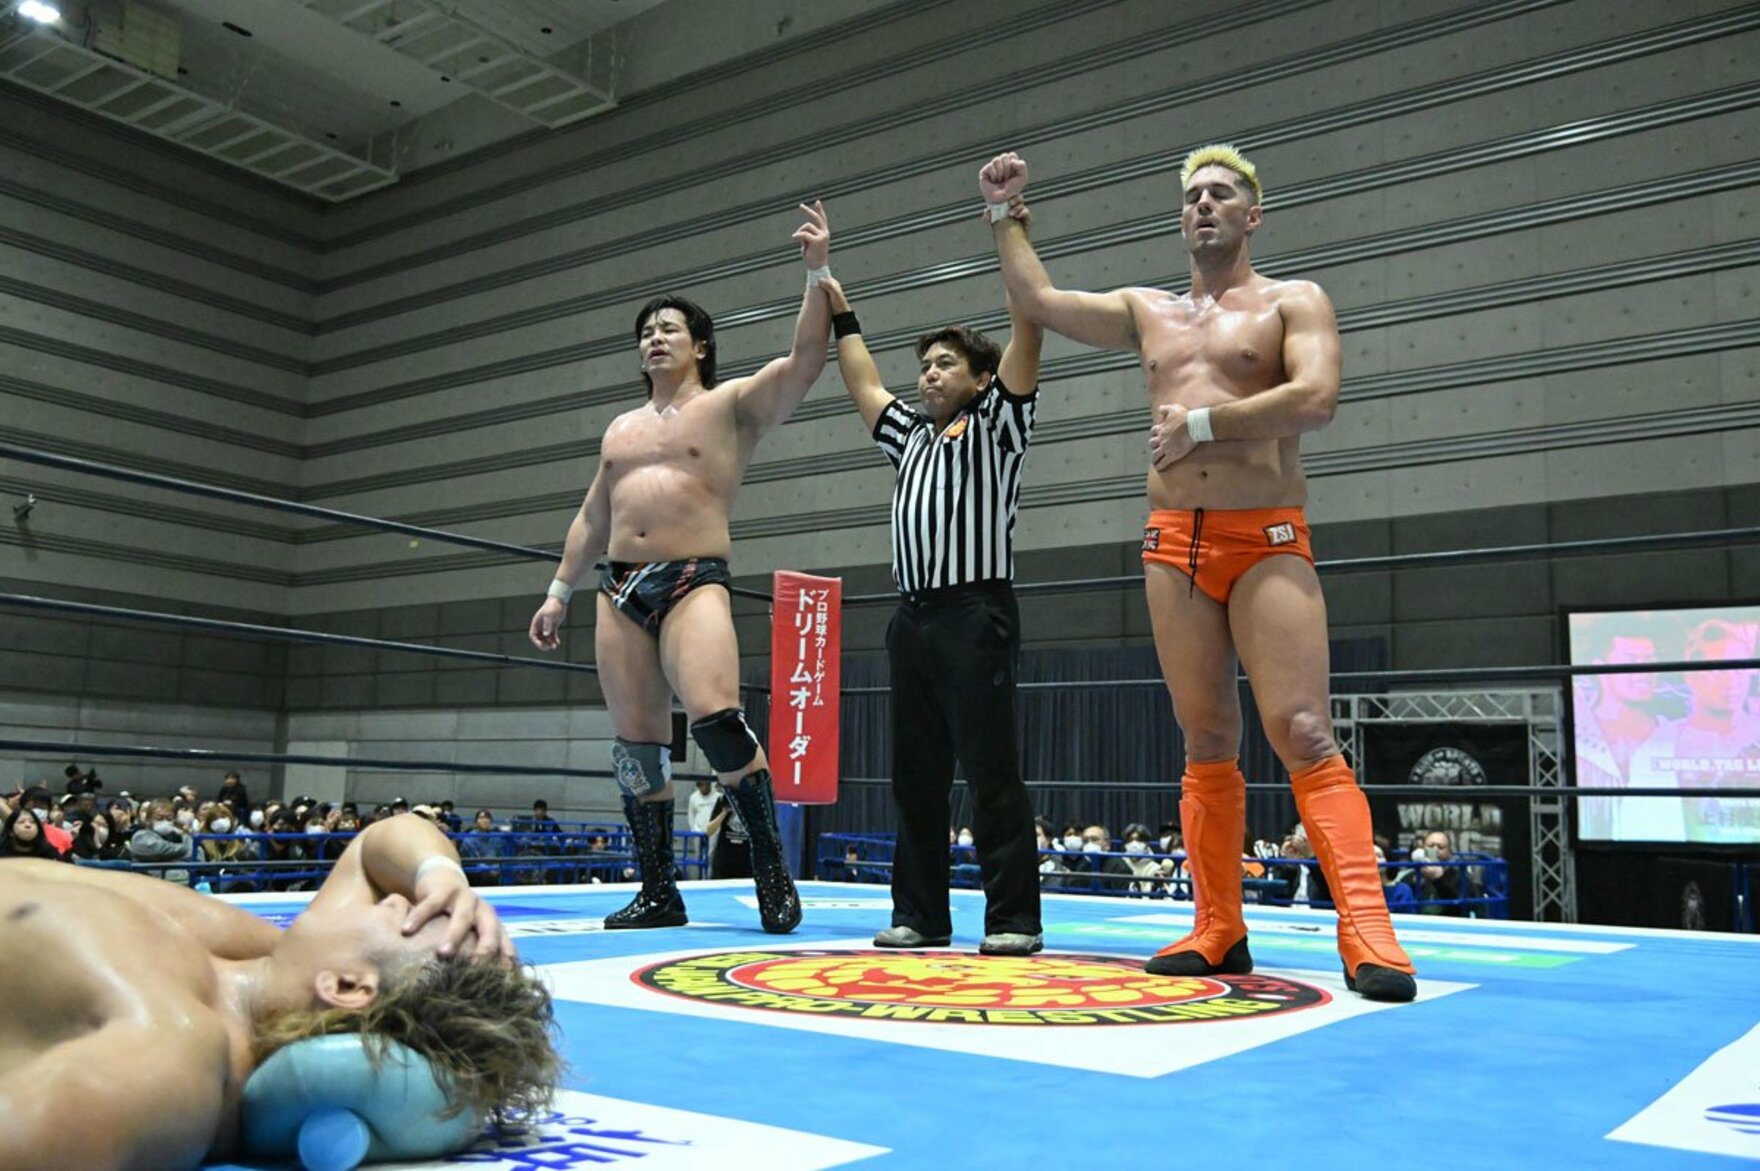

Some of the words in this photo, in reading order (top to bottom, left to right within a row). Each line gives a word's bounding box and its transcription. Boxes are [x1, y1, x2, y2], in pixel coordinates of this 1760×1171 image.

[788, 588, 816, 785] ドリームオーダー
[812, 588, 830, 707] プロ野球カードゲーム
